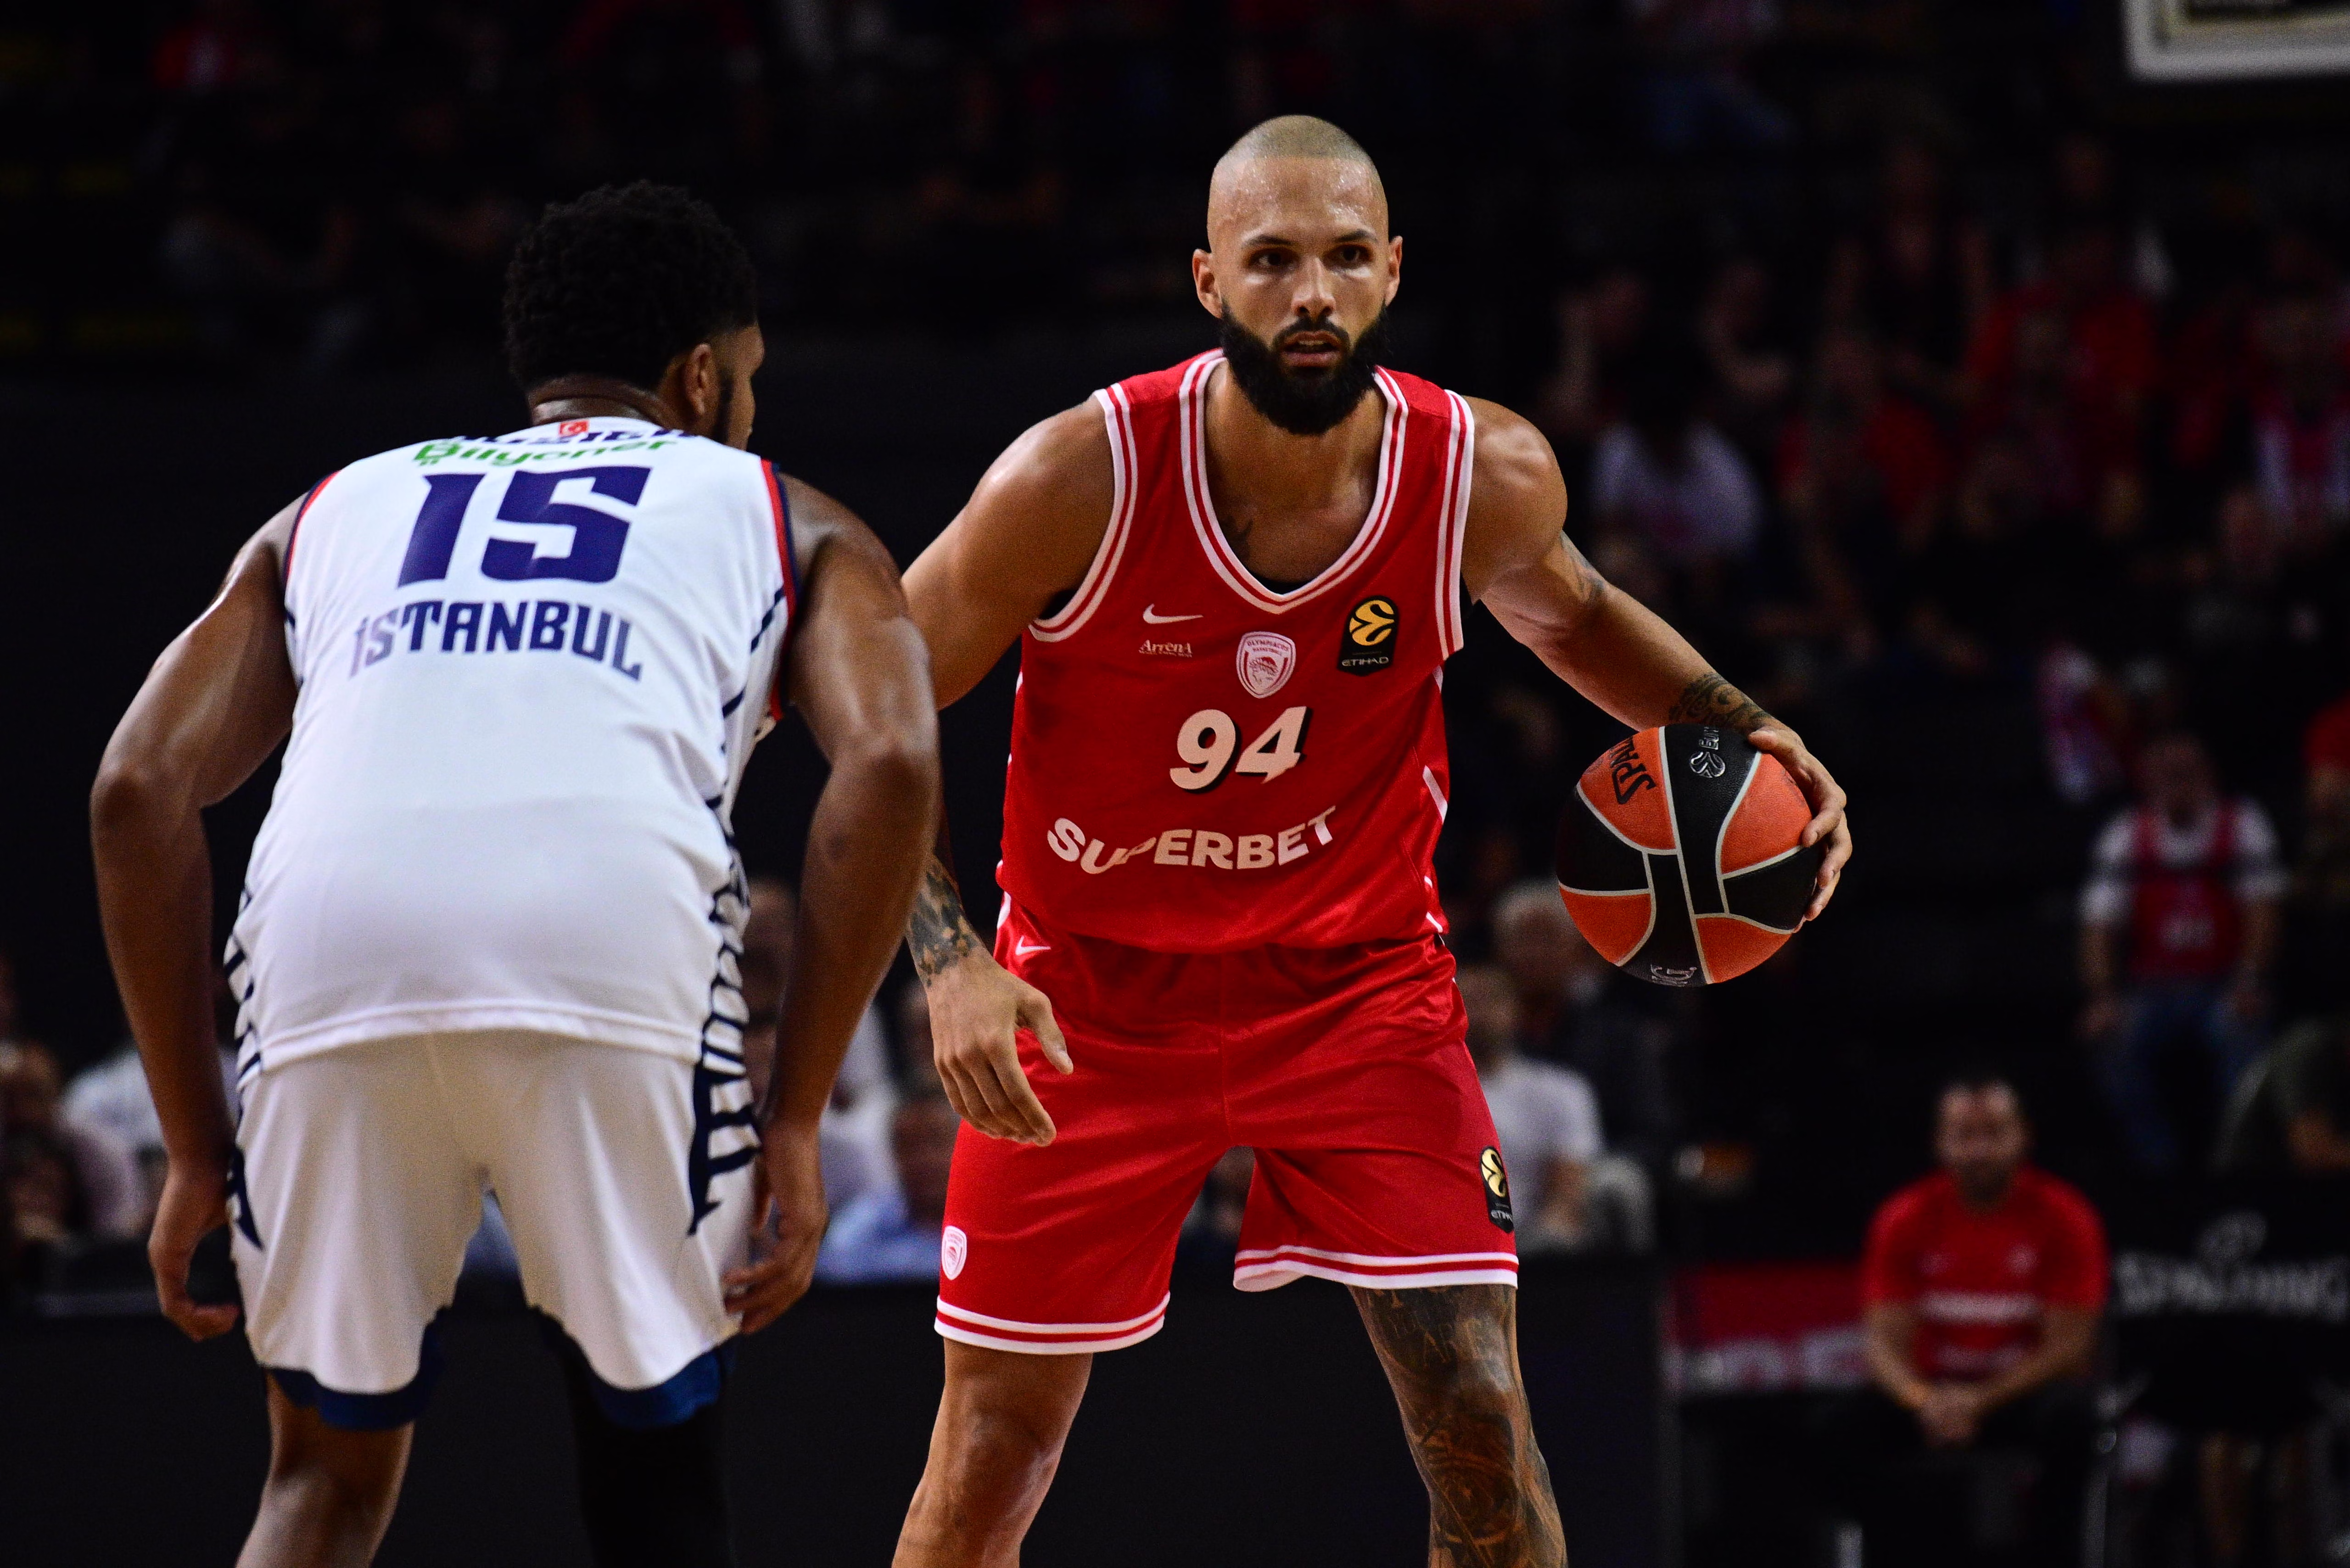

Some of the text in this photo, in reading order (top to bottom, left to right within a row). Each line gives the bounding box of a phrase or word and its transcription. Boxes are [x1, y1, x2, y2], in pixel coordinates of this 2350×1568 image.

[414, 439, 677, 466] Bilyoner
[397, 466, 652, 588] 15
[1341, 656, 1389, 667] ETIHAD
[1169, 705, 1312, 791] 94
[1047, 806, 1336, 875] SUPERBET
